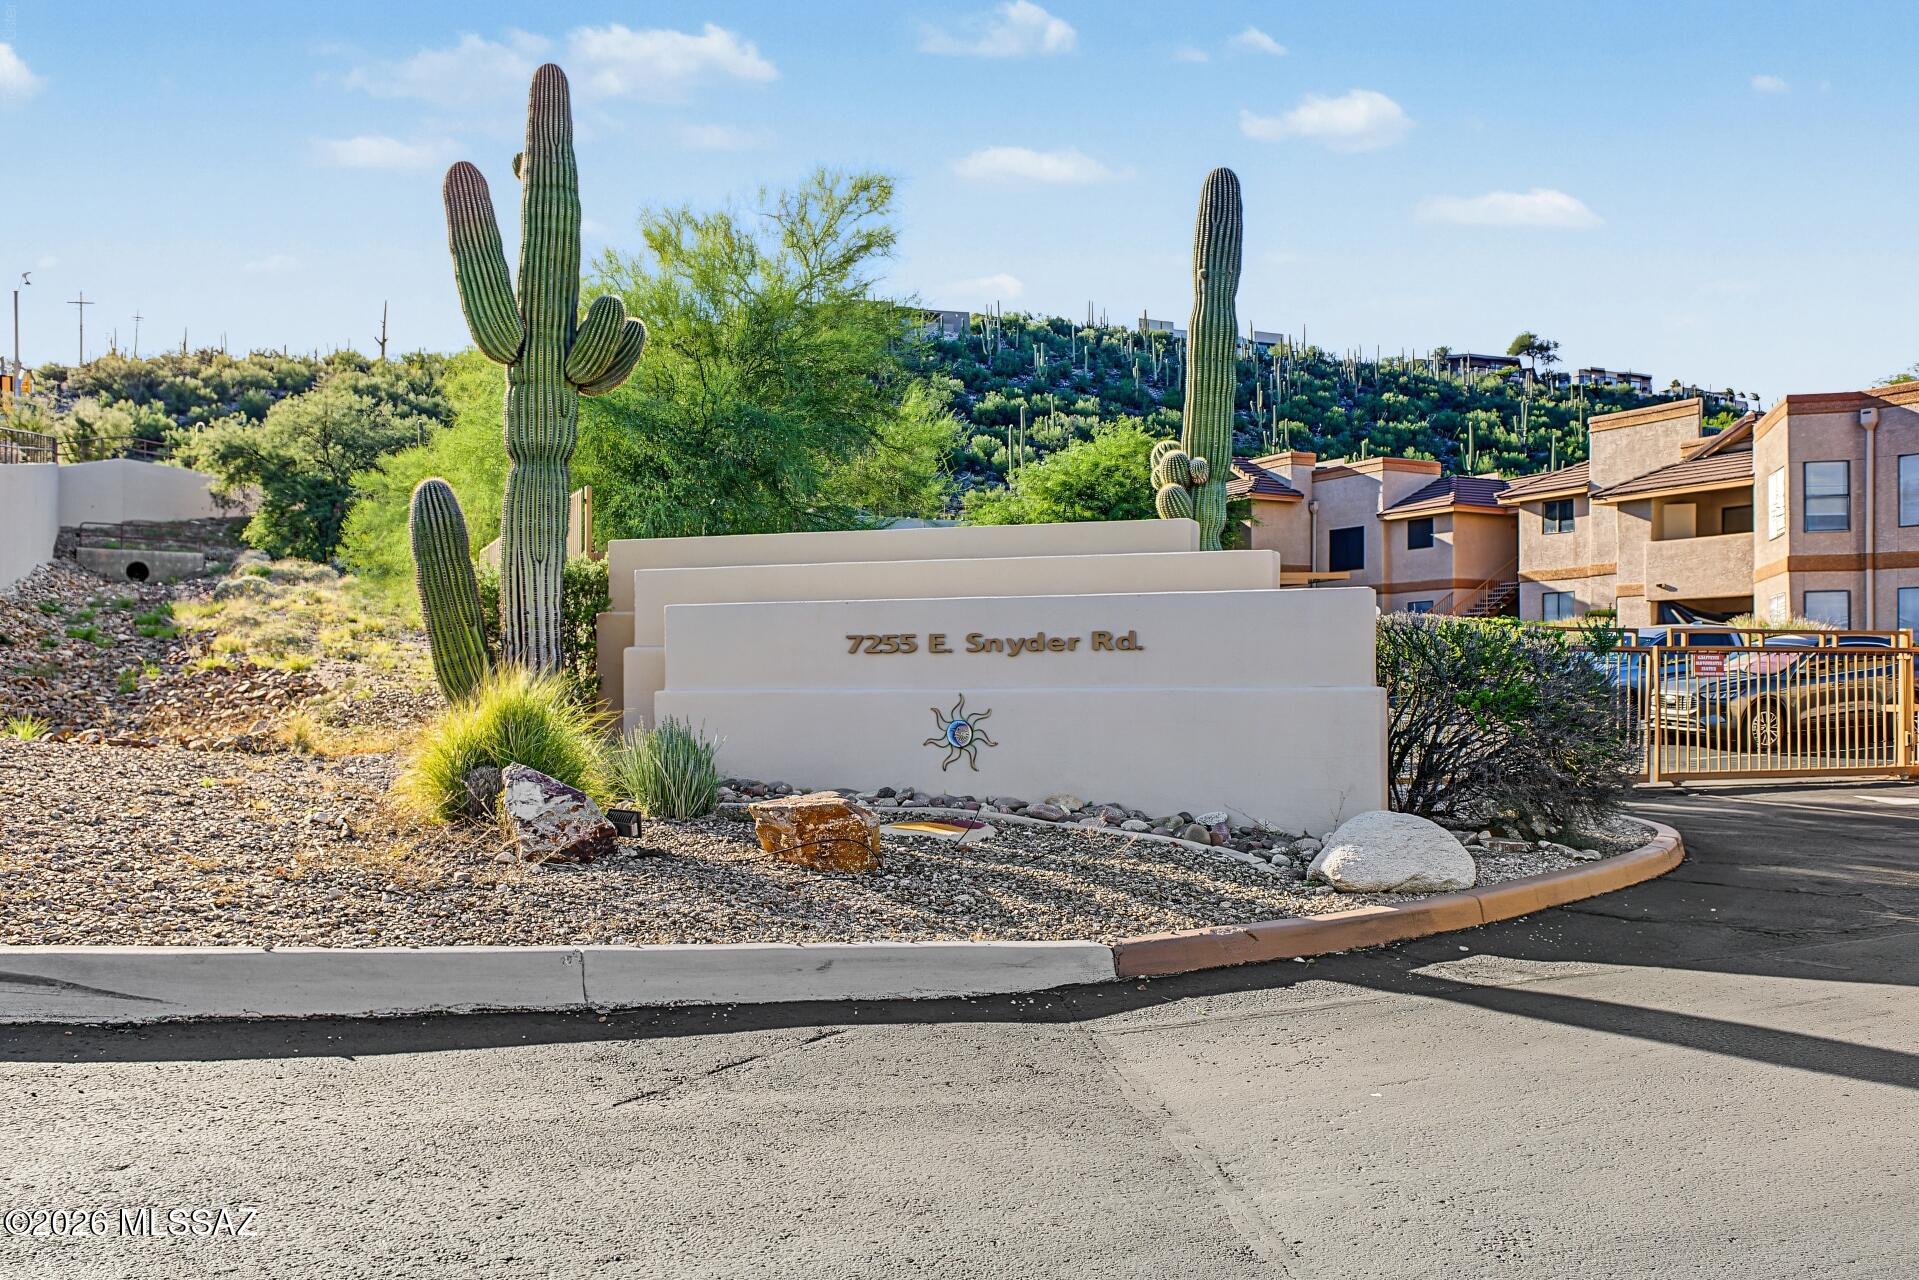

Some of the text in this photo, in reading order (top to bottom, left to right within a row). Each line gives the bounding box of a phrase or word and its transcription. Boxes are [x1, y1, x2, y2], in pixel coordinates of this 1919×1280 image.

[846, 630, 1145, 657] 7255 E. Snyder Rd.
